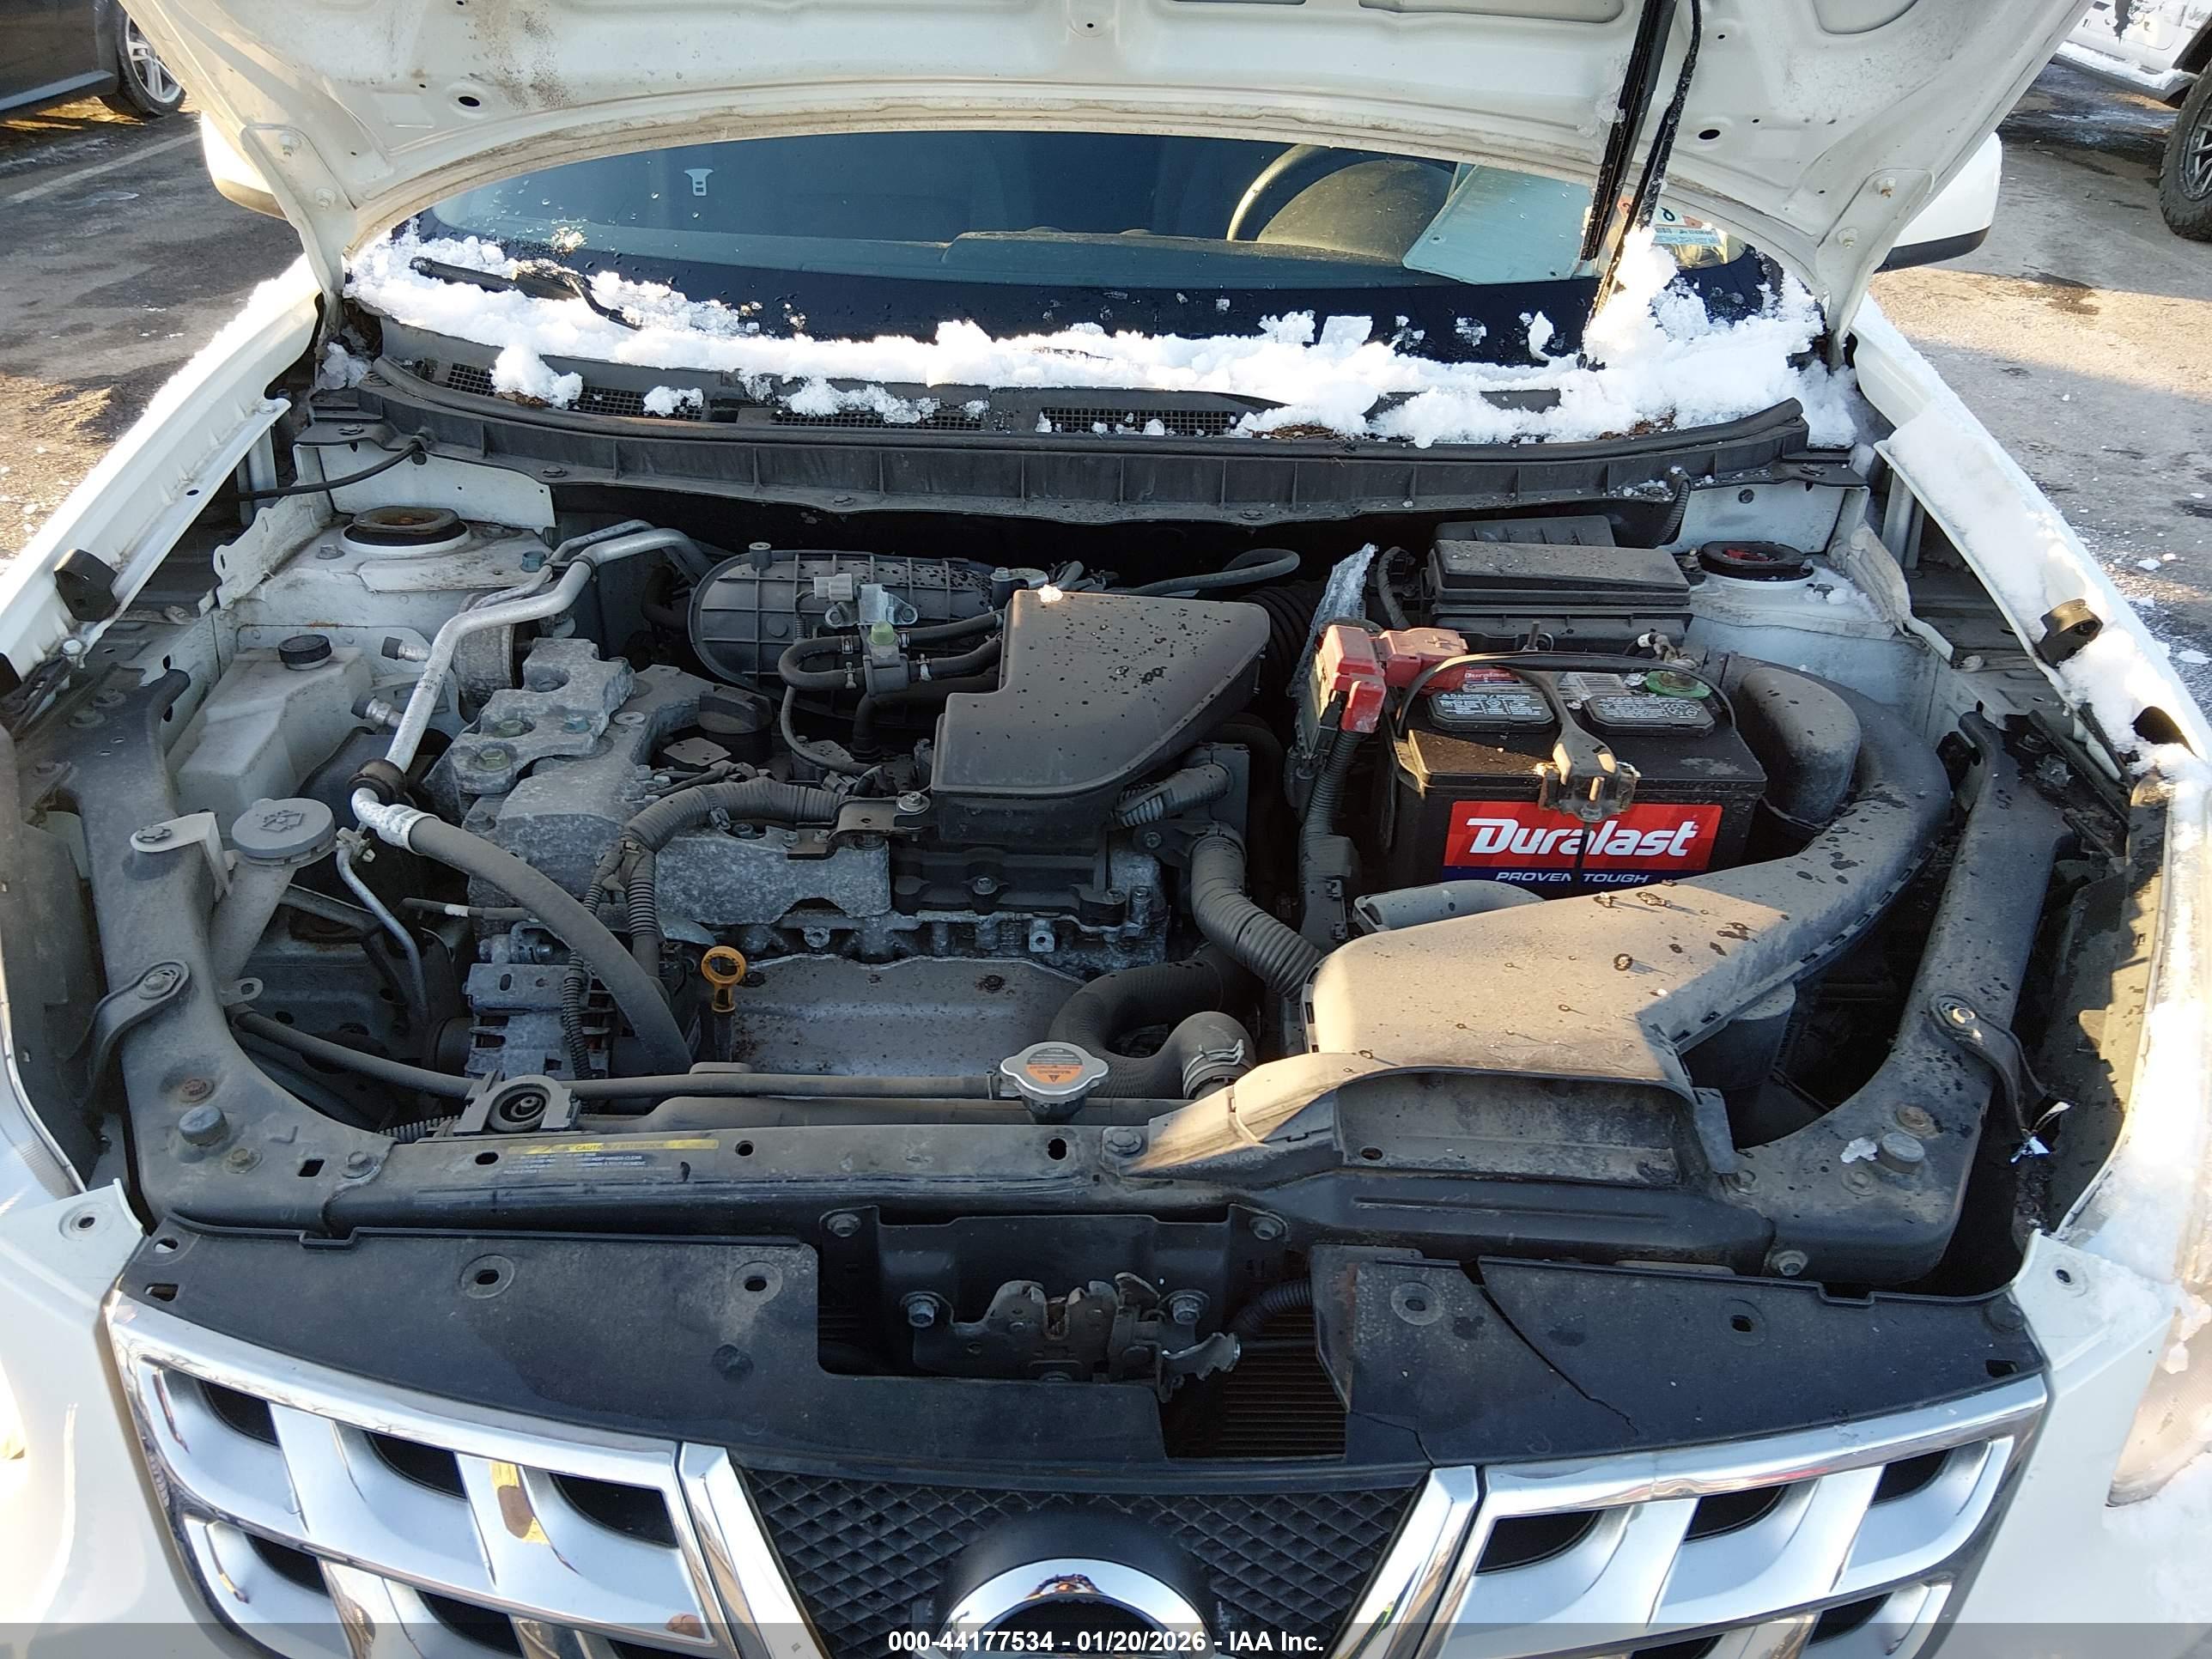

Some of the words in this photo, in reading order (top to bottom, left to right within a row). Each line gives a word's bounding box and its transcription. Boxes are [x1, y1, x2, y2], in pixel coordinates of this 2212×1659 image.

[1465, 817, 1697, 856] Duralast
[1495, 872, 1572, 882] PROVEN
[1582, 873, 1650, 884] TOUGH
